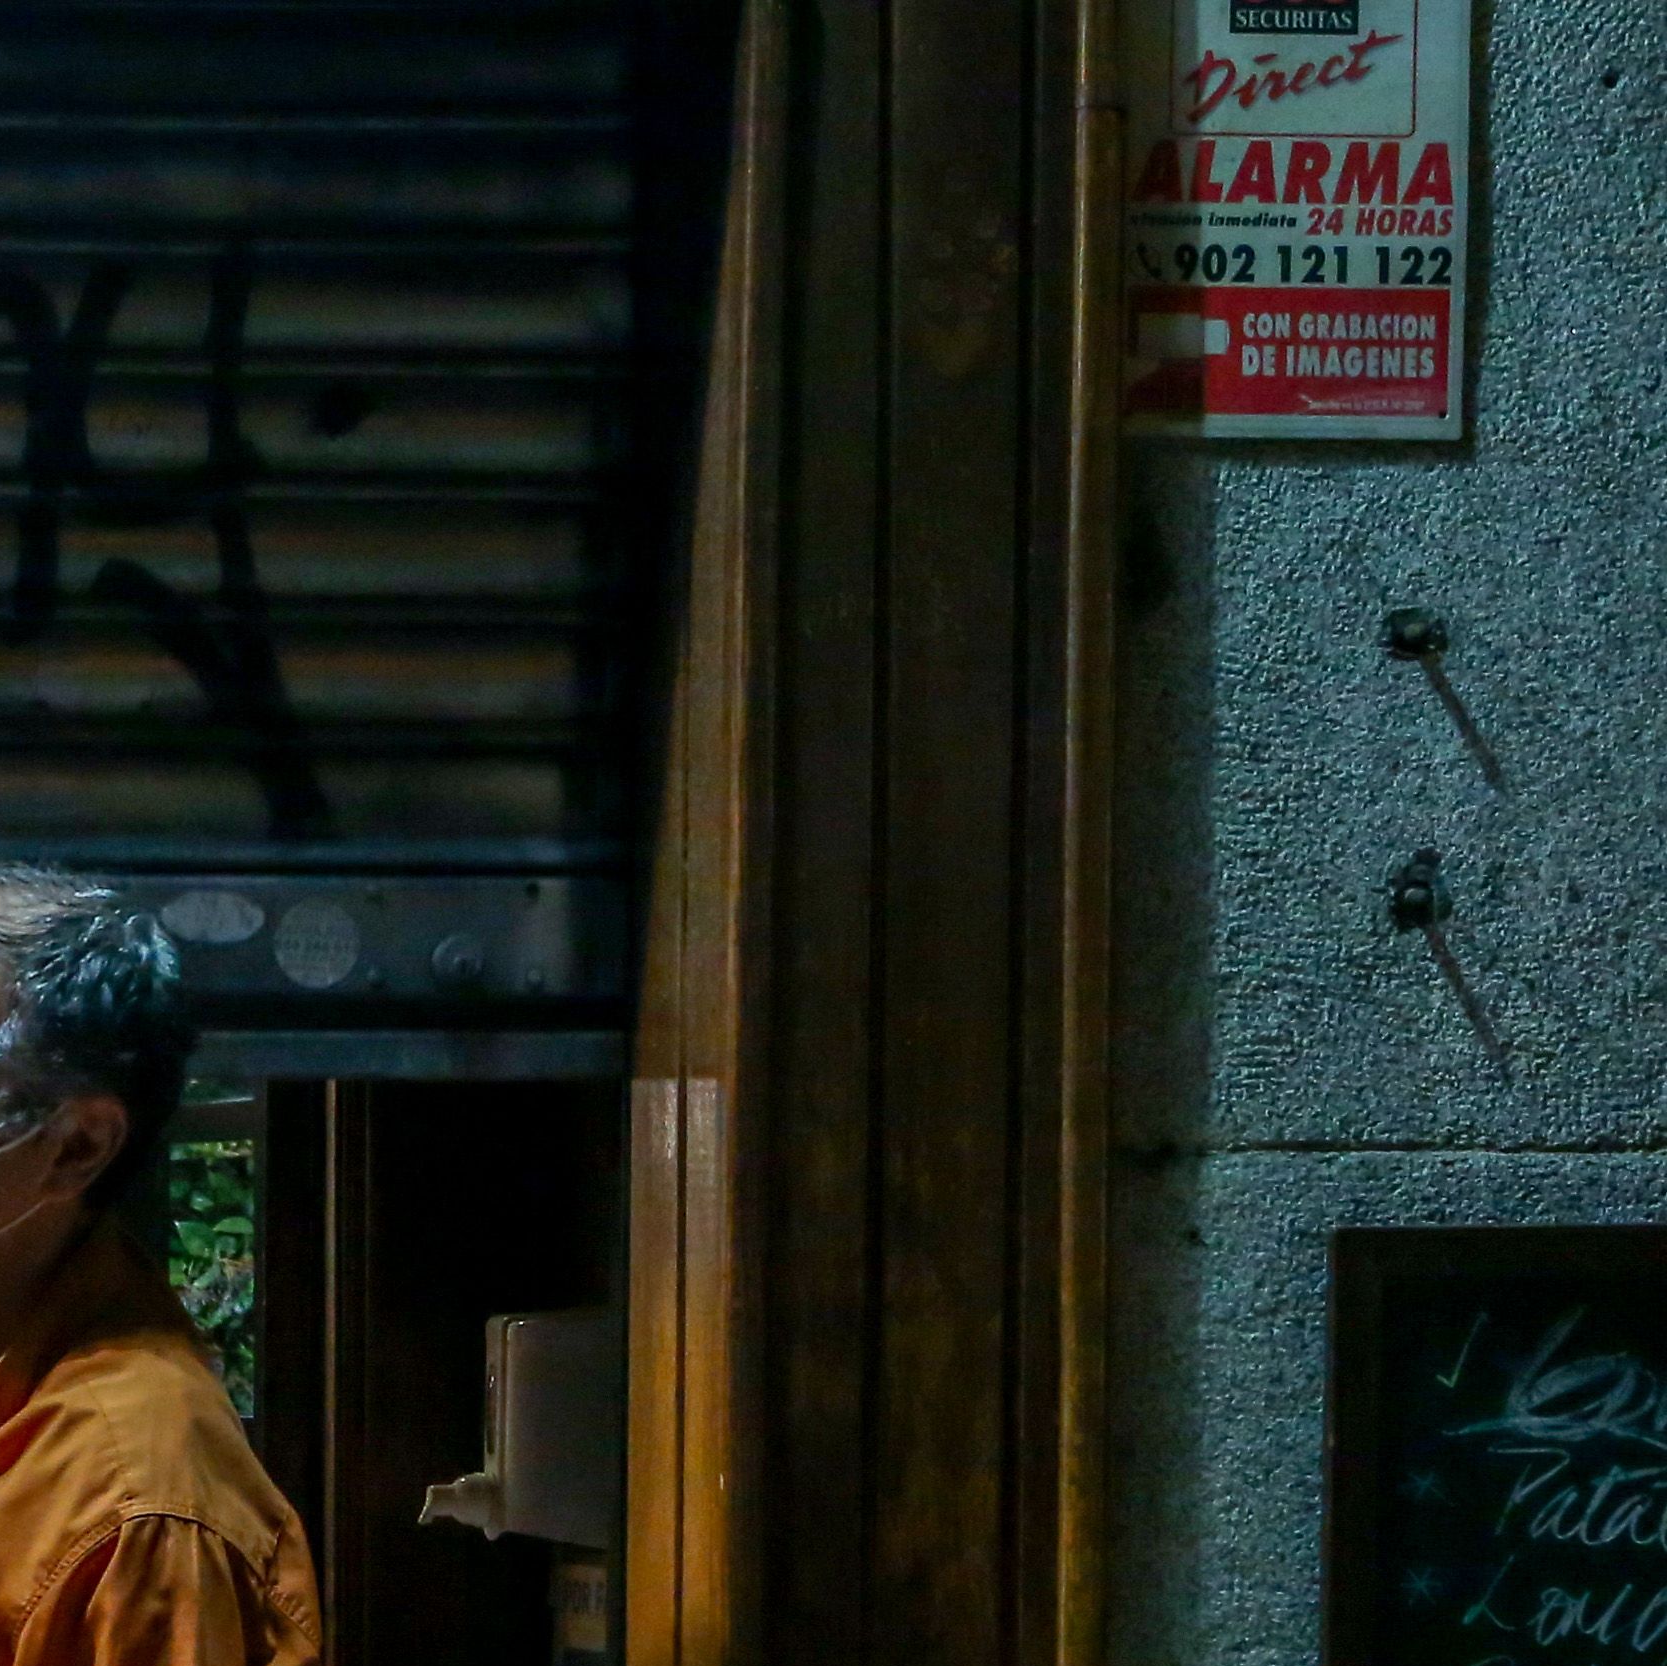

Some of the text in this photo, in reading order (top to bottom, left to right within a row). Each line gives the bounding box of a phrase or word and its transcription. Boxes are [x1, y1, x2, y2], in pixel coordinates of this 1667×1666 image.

[1234, 9, 1354, 30] SECURITAS
[1184, 30, 1404, 124] Direct
[1131, 139, 1454, 206] ALARMA
[1208, 212, 1298, 228] inmediata
[1305, 207, 1344, 236] 24
[1355, 207, 1454, 237] HORAS
[1175, 244, 1453, 285] 902 121 122
[1241, 312, 1437, 341] CON GRABACION
[1241, 345, 1436, 379] DE IMAGENES
